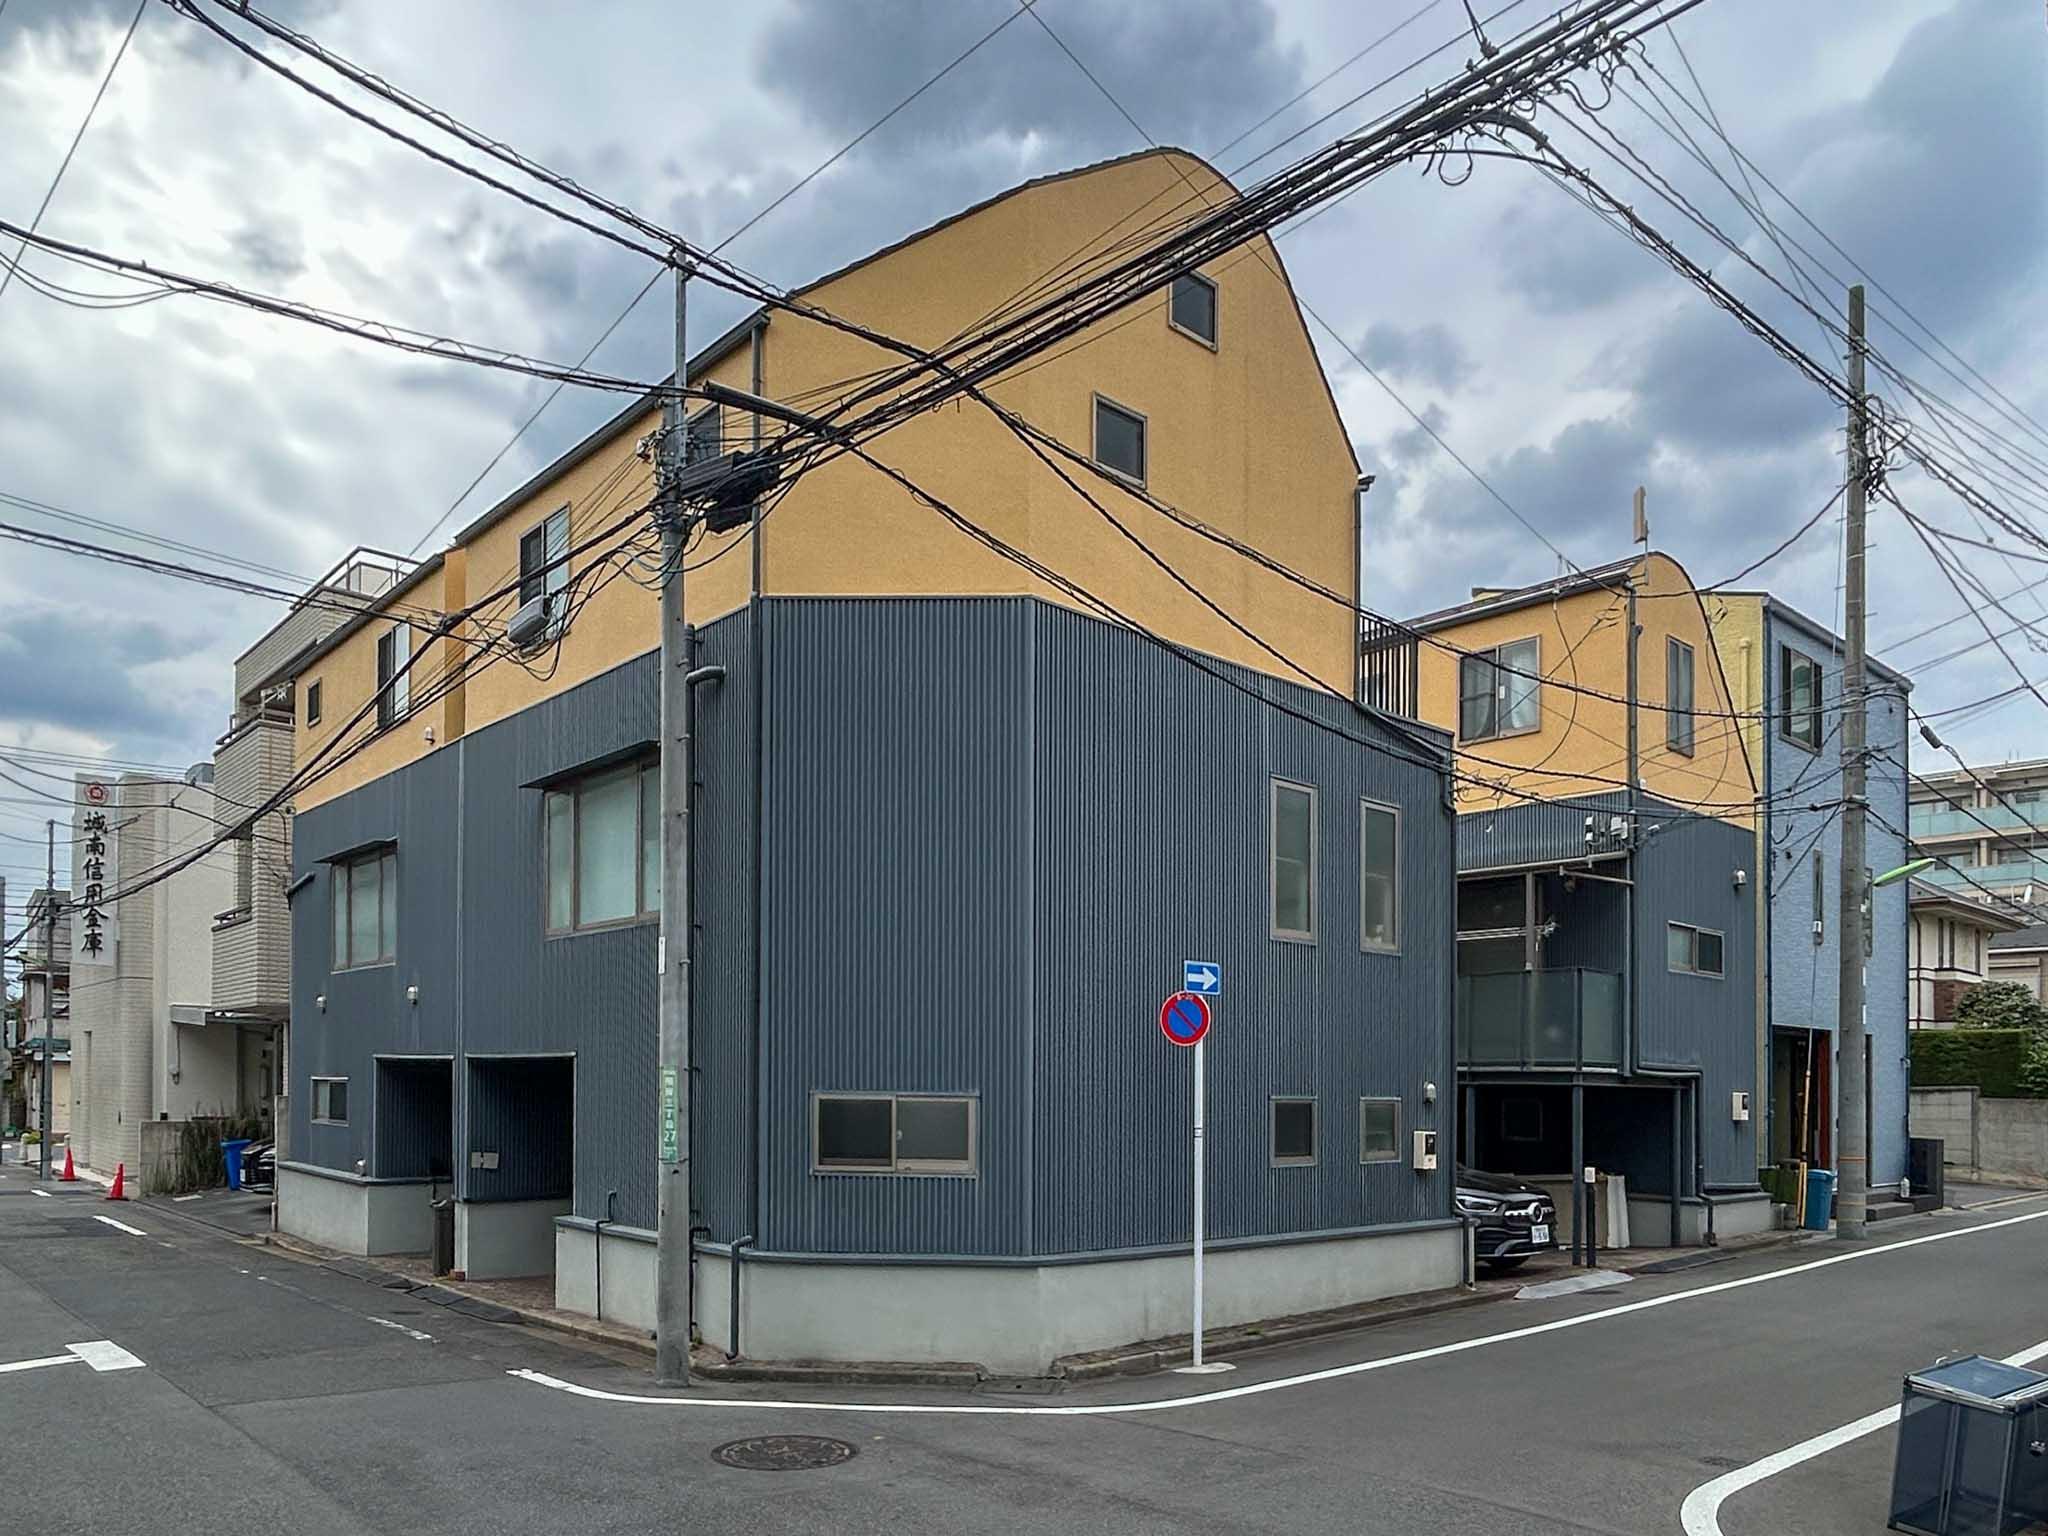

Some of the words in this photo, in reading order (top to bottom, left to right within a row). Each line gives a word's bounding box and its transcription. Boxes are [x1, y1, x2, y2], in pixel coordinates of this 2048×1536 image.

[81, 811, 109, 959] 城南信用金庫
[663, 1130, 677, 1142] 27
